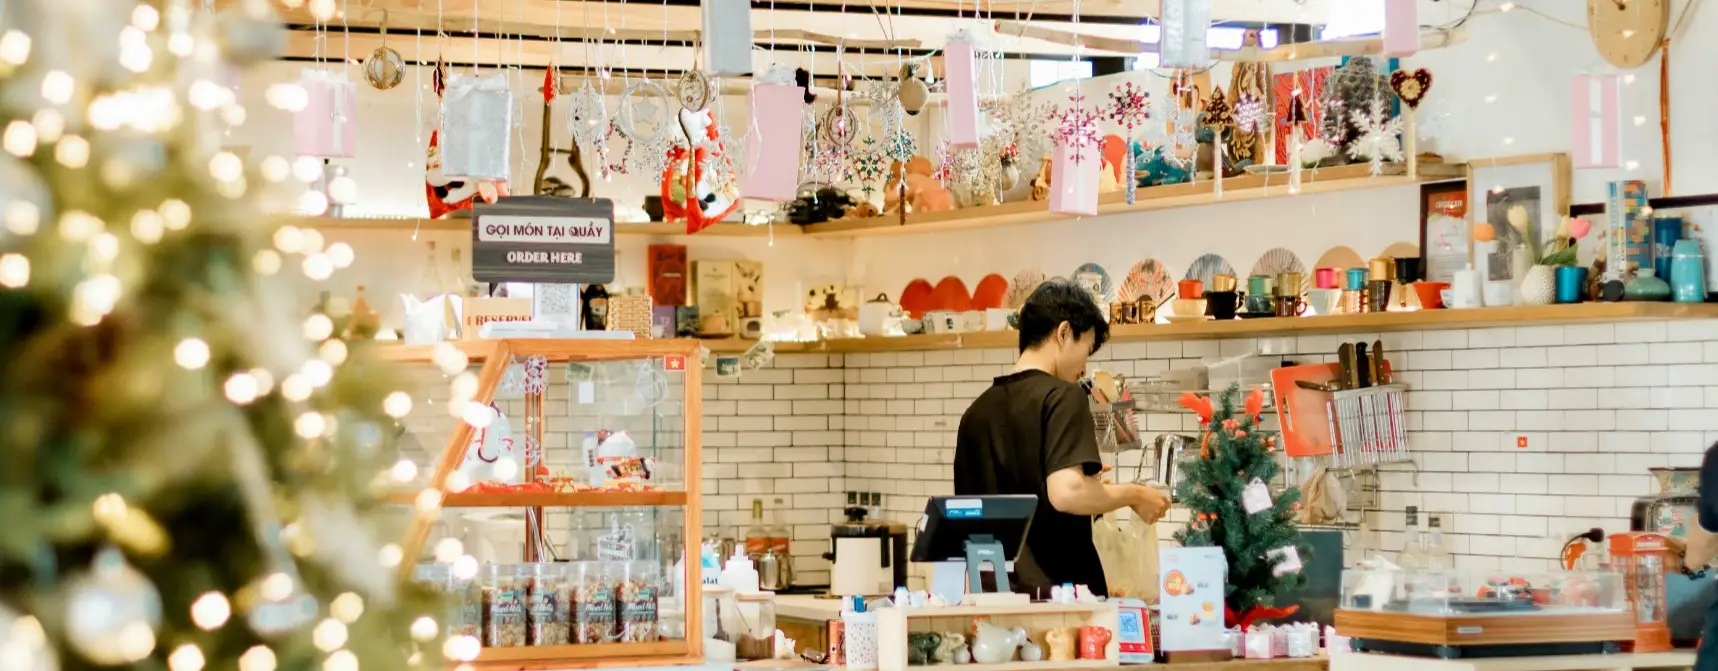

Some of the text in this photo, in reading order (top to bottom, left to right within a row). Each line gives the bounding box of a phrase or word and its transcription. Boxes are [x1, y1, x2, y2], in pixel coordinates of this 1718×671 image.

[485, 224, 510, 239] GỌI
[513, 222, 543, 236] MÓN
[547, 225, 565, 240] TẠI
[506, 250, 583, 264] ORDER HERE
